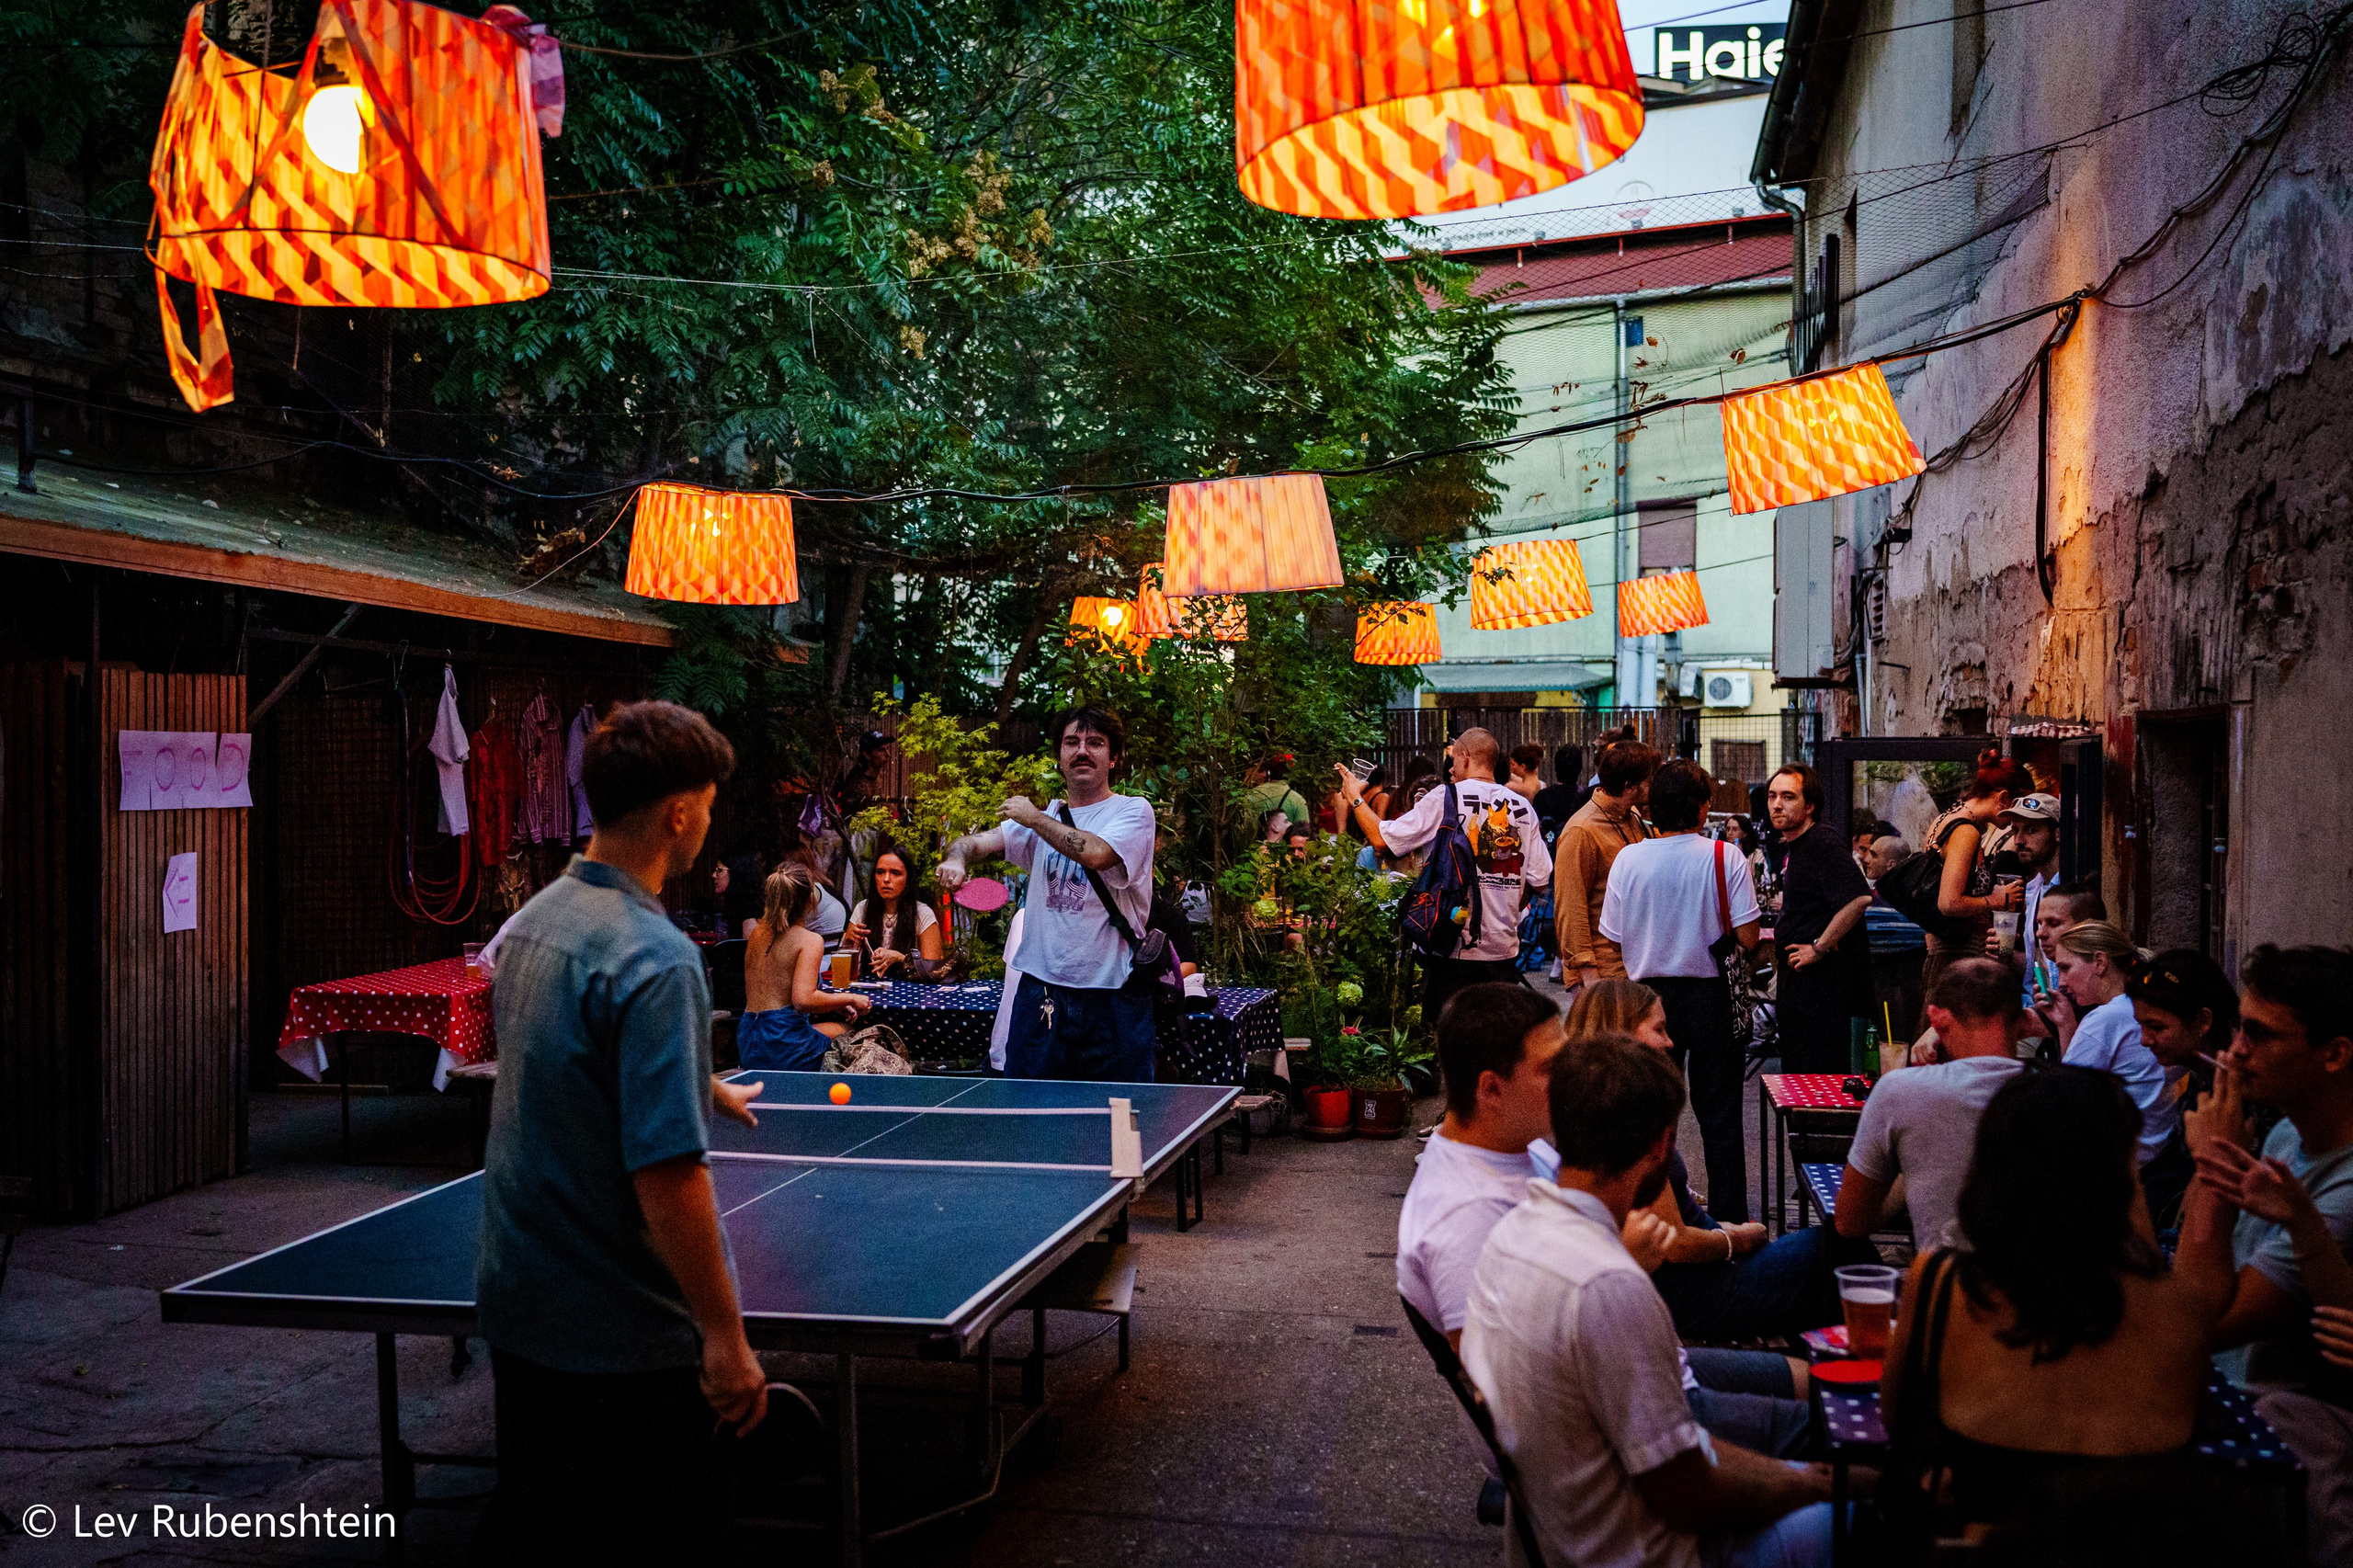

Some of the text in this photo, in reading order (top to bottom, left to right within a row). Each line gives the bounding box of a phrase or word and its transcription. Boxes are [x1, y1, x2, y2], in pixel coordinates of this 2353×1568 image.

[121, 743, 244, 795] FOOD
[1462, 794, 1529, 820] ラーメン
